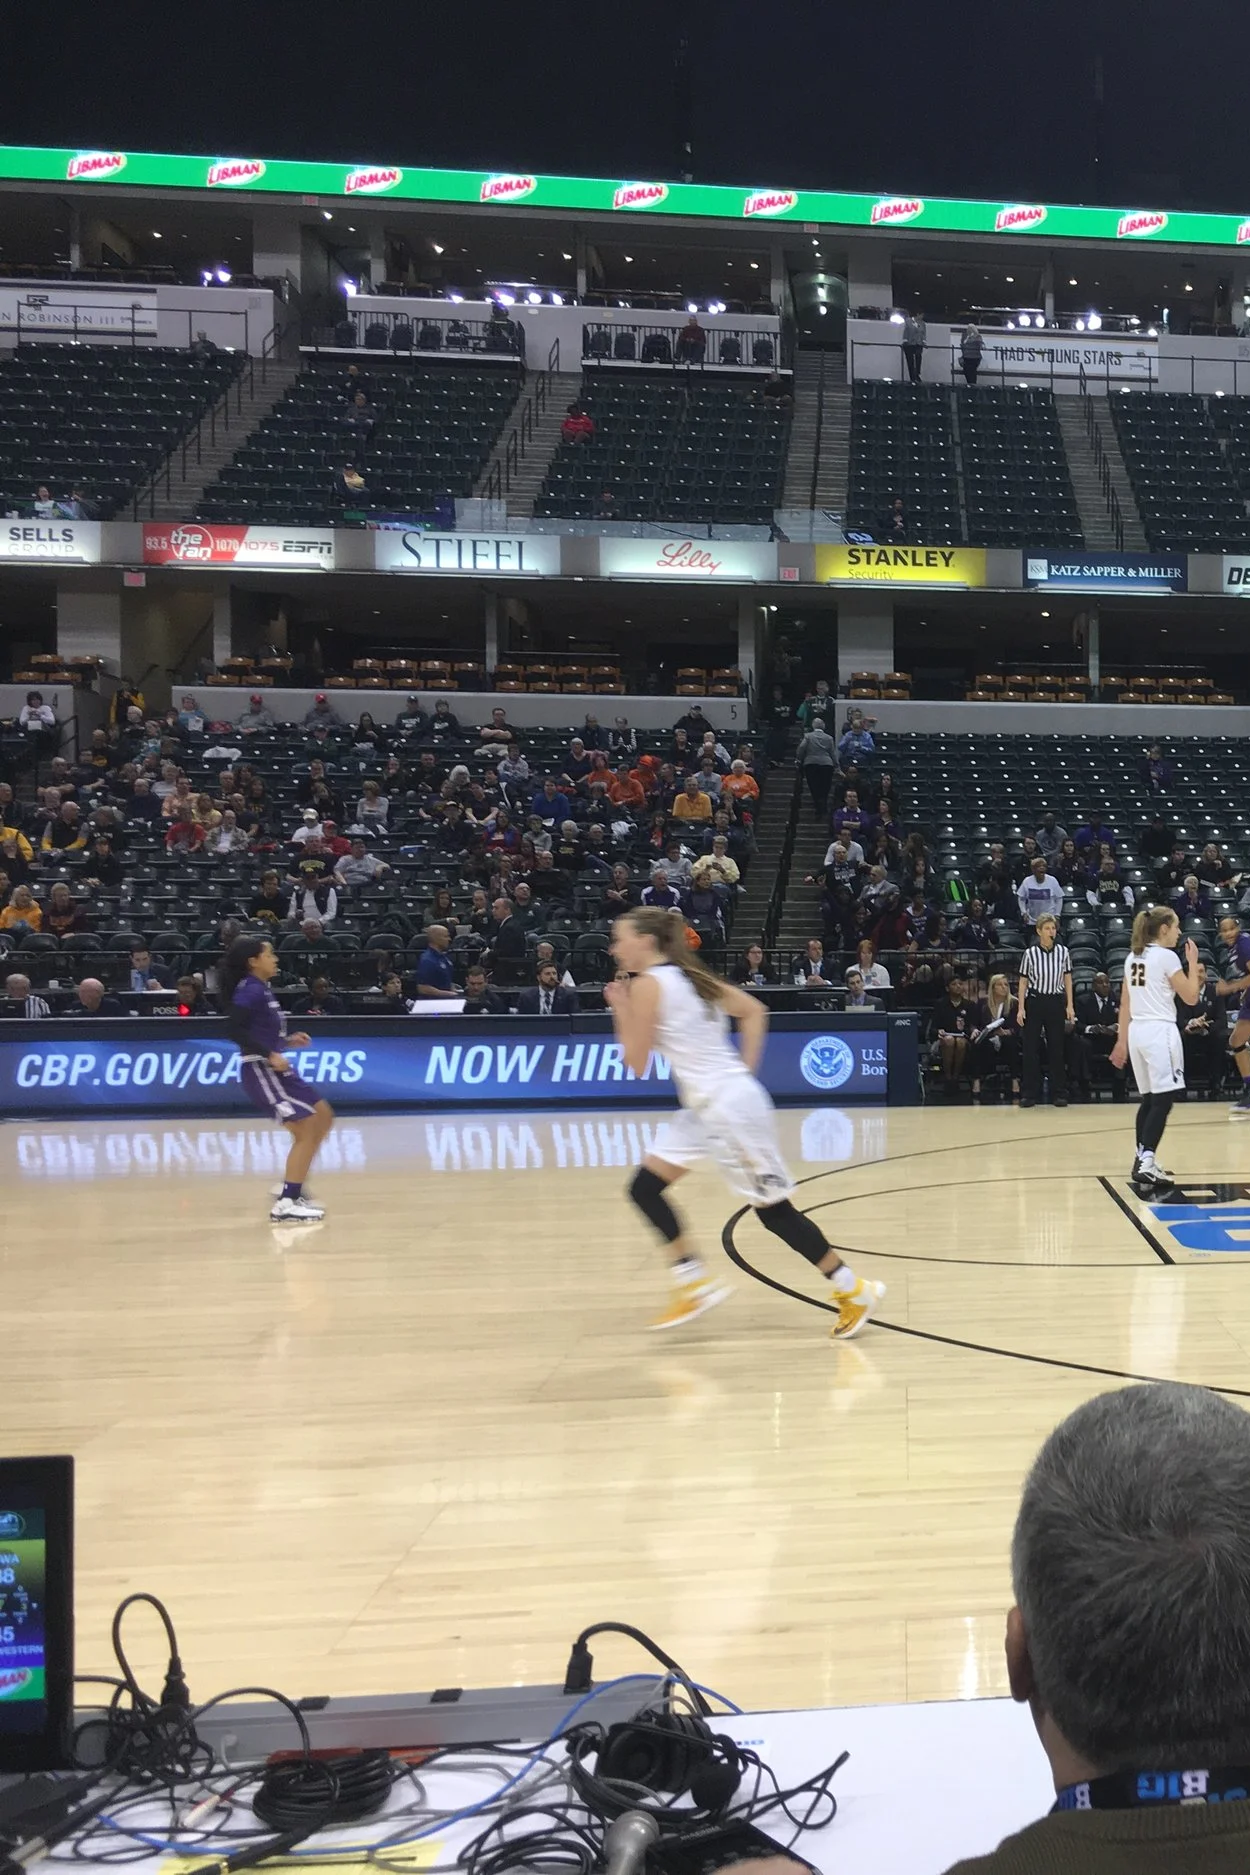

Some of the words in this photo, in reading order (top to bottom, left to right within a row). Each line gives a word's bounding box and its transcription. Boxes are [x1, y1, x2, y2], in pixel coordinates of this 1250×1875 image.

[67, 155, 122, 179] LIBMAN
[207, 163, 261, 185] LIBMAN
[345, 170, 398, 193] LIBMAN
[480, 178, 533, 200] LIBMAN
[614, 186, 664, 208] LIBMAN
[744, 194, 793, 216] LIBMAN
[871, 201, 920, 223] LIBMAN
[996, 208, 1043, 230] LIBMAN
[1118, 215, 1164, 236] LIBMAN
[18, 313, 93, 324] ROBINSON
[993, 346, 1036, 362] THAD'S
[1041, 349, 1080, 364] YOUNG
[1083, 351, 1122, 366] STARS
[9, 527, 74, 542] SELLS
[170, 530, 203, 545] the
[215, 539, 240, 552] 1070
[282, 540, 332, 554] ESPN
[178, 546, 212, 561] fan
[656, 541, 722, 575] Lilly
[847, 548, 955, 568] STANLEY
[1050, 564, 1081, 577] KATZ
[1082, 565, 1127, 578] SAPPER
[1127, 568, 1137, 578] &
[1138, 567, 1184, 579] MILLER
[1130, 961, 1146, 988] 22
[152, 1006, 179, 1015] POSS
[424, 1044, 545, 1084] NOW
[551, 1043, 673, 1082] HIRN
[861, 1048, 887, 1061] U.S.
[16, 1050, 368, 1089] CBP.GOV/CAERS
[861, 1063, 888, 1076] Bor
